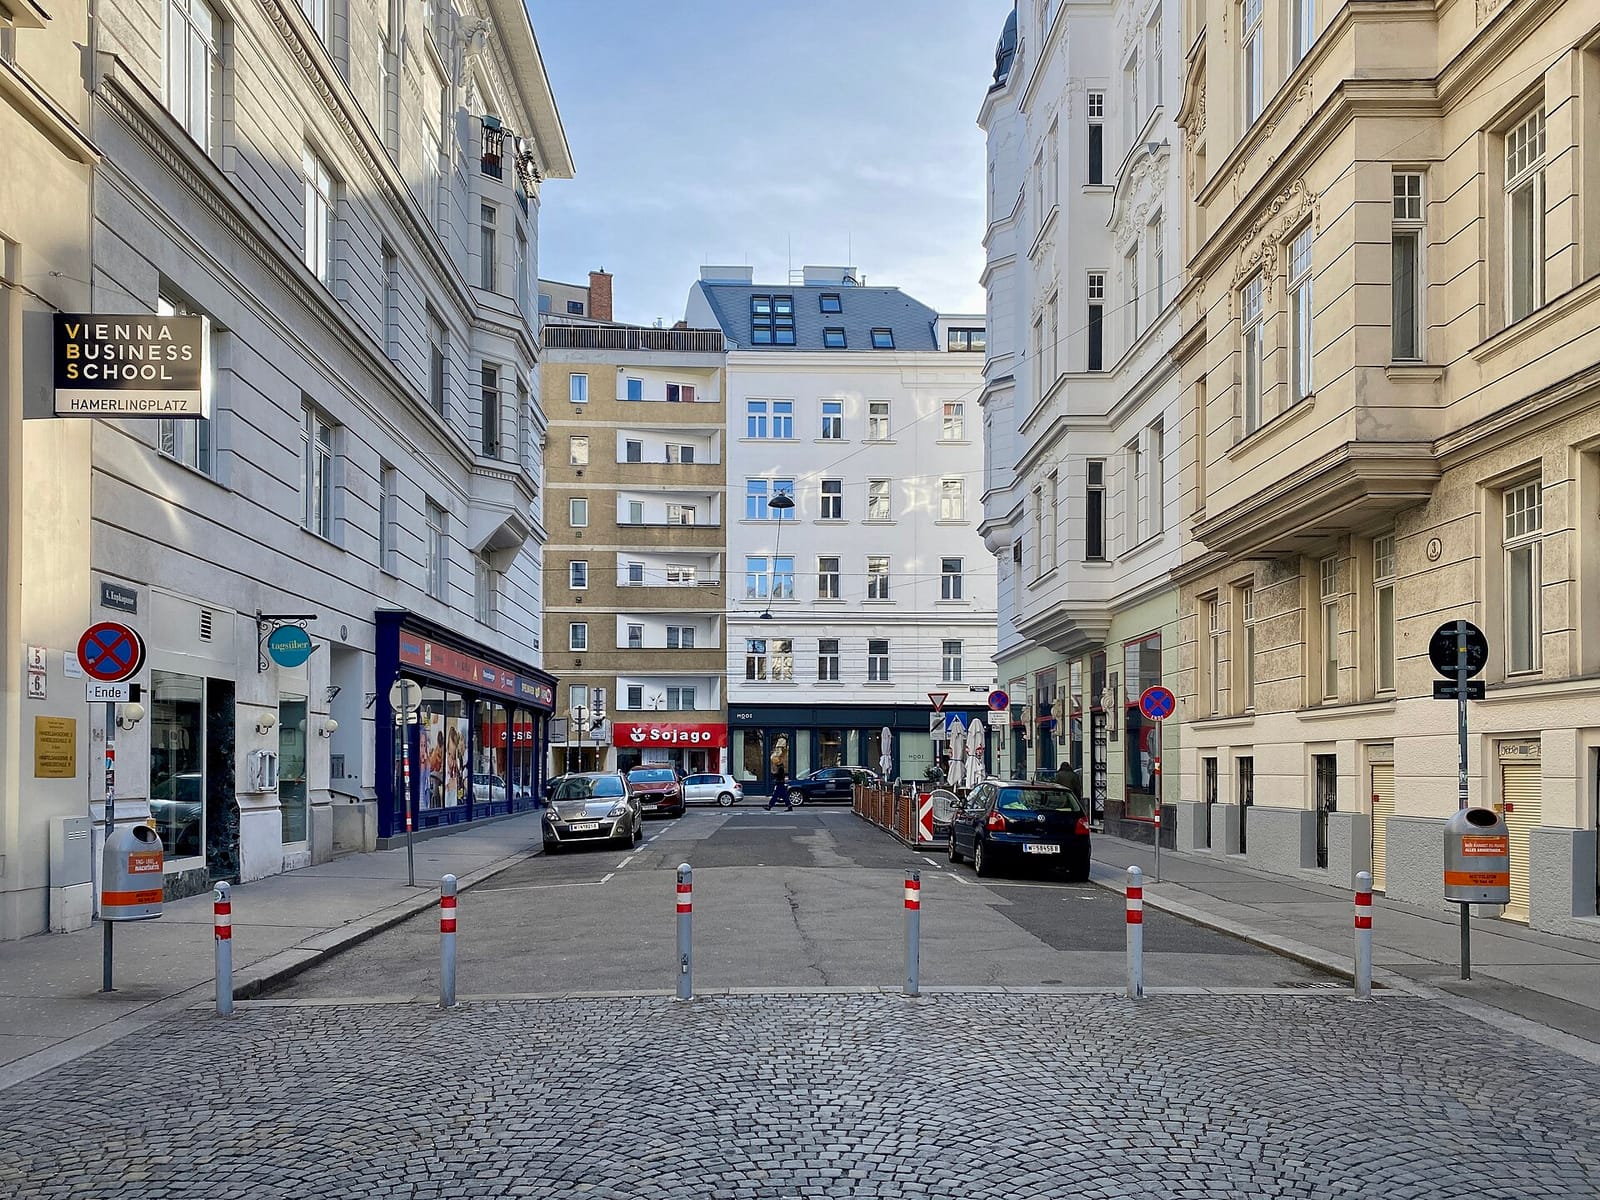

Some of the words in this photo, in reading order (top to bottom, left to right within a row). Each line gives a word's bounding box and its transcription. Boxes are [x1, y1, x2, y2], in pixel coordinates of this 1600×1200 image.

[65, 323, 173, 340] VIENNA
[66, 344, 193, 361] BUSINESS
[66, 363, 173, 380] SCHOOL
[71, 399, 188, 411] HAMERLINGPLATZ
[271, 640, 308, 653] tagsüber
[34, 649, 41, 665] 5
[34, 675, 41, 691] 6
[95, 686, 121, 698] Ende
[649, 728, 711, 743] Sojago
